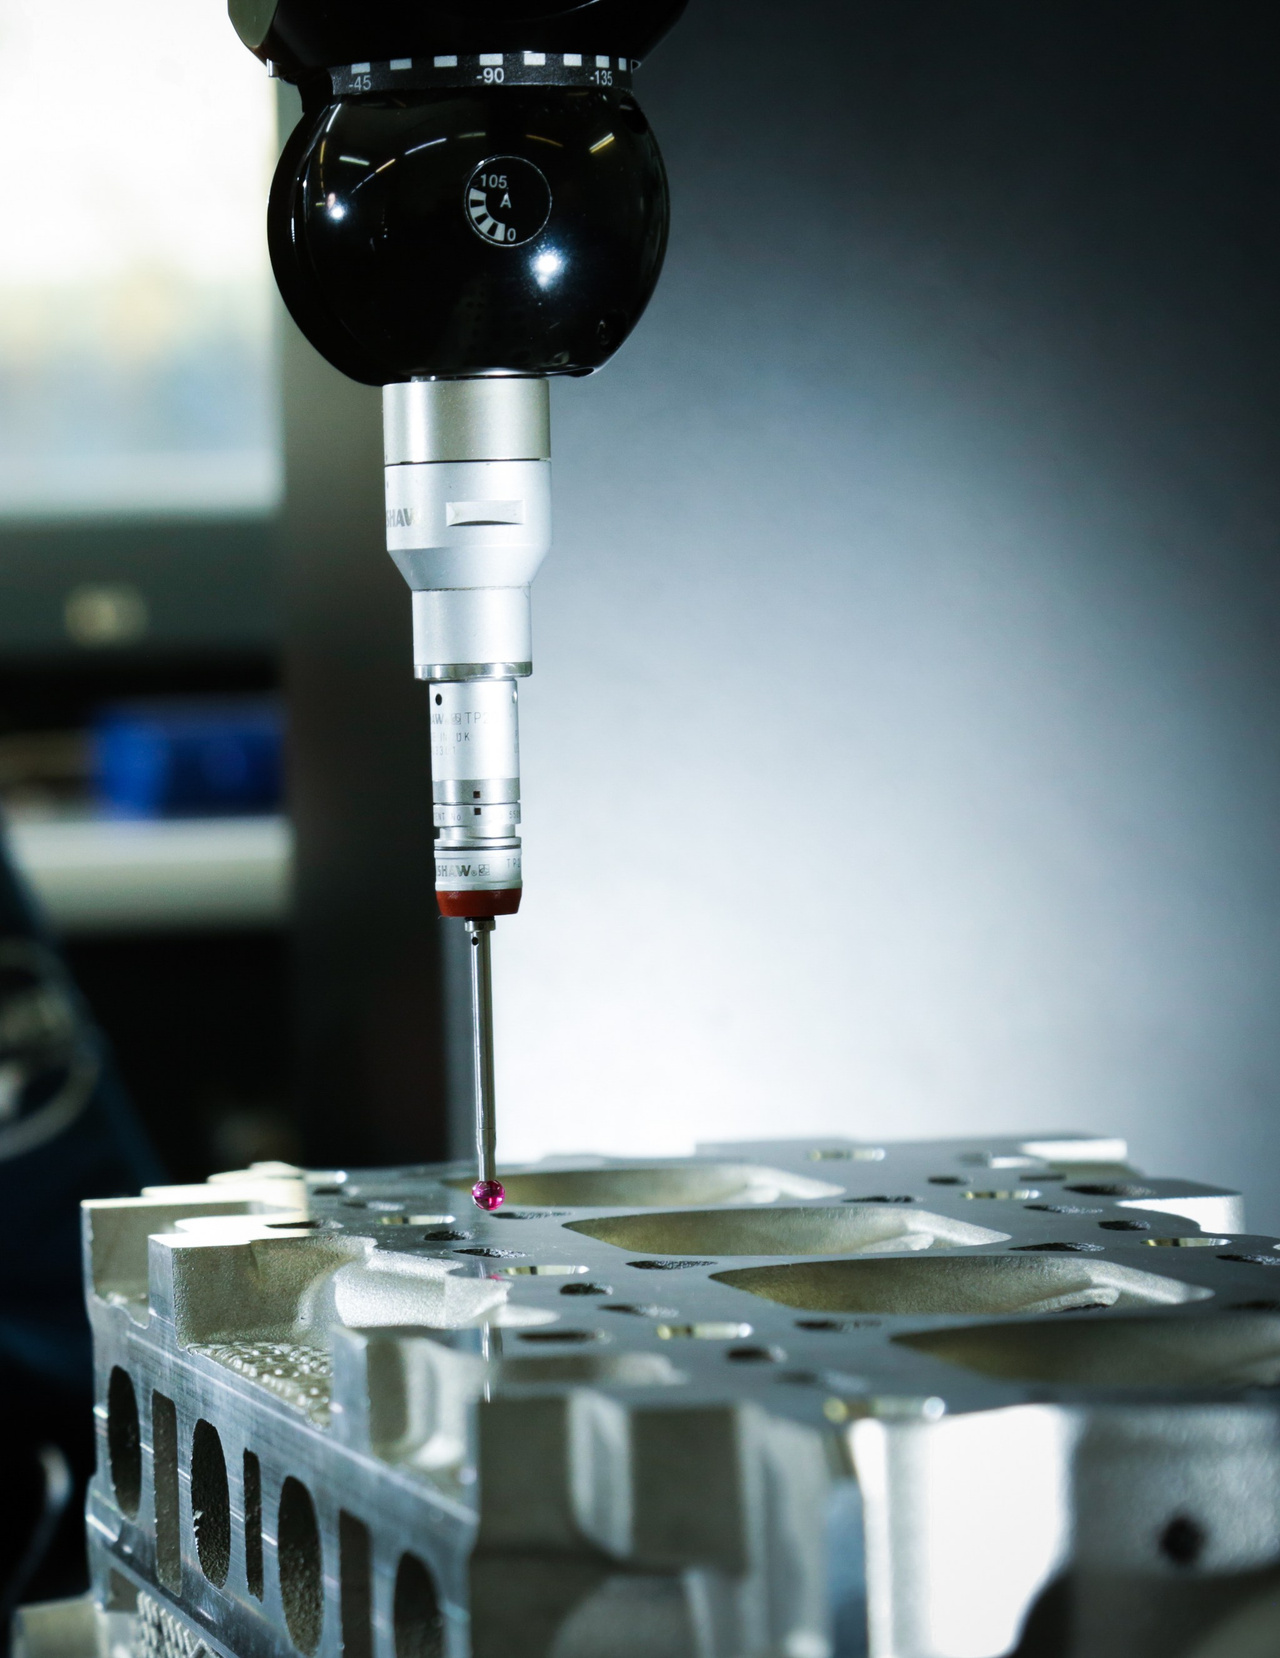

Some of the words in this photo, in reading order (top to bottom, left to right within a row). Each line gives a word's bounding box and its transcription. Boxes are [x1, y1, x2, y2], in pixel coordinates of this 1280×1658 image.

[348, 75, 372, 91] -45
[476, 67, 505, 84] -90
[589, 70, 613, 86] -135
[480, 173, 508, 189] 105
[500, 192, 512, 209] A
[507, 227, 517, 242] 0
